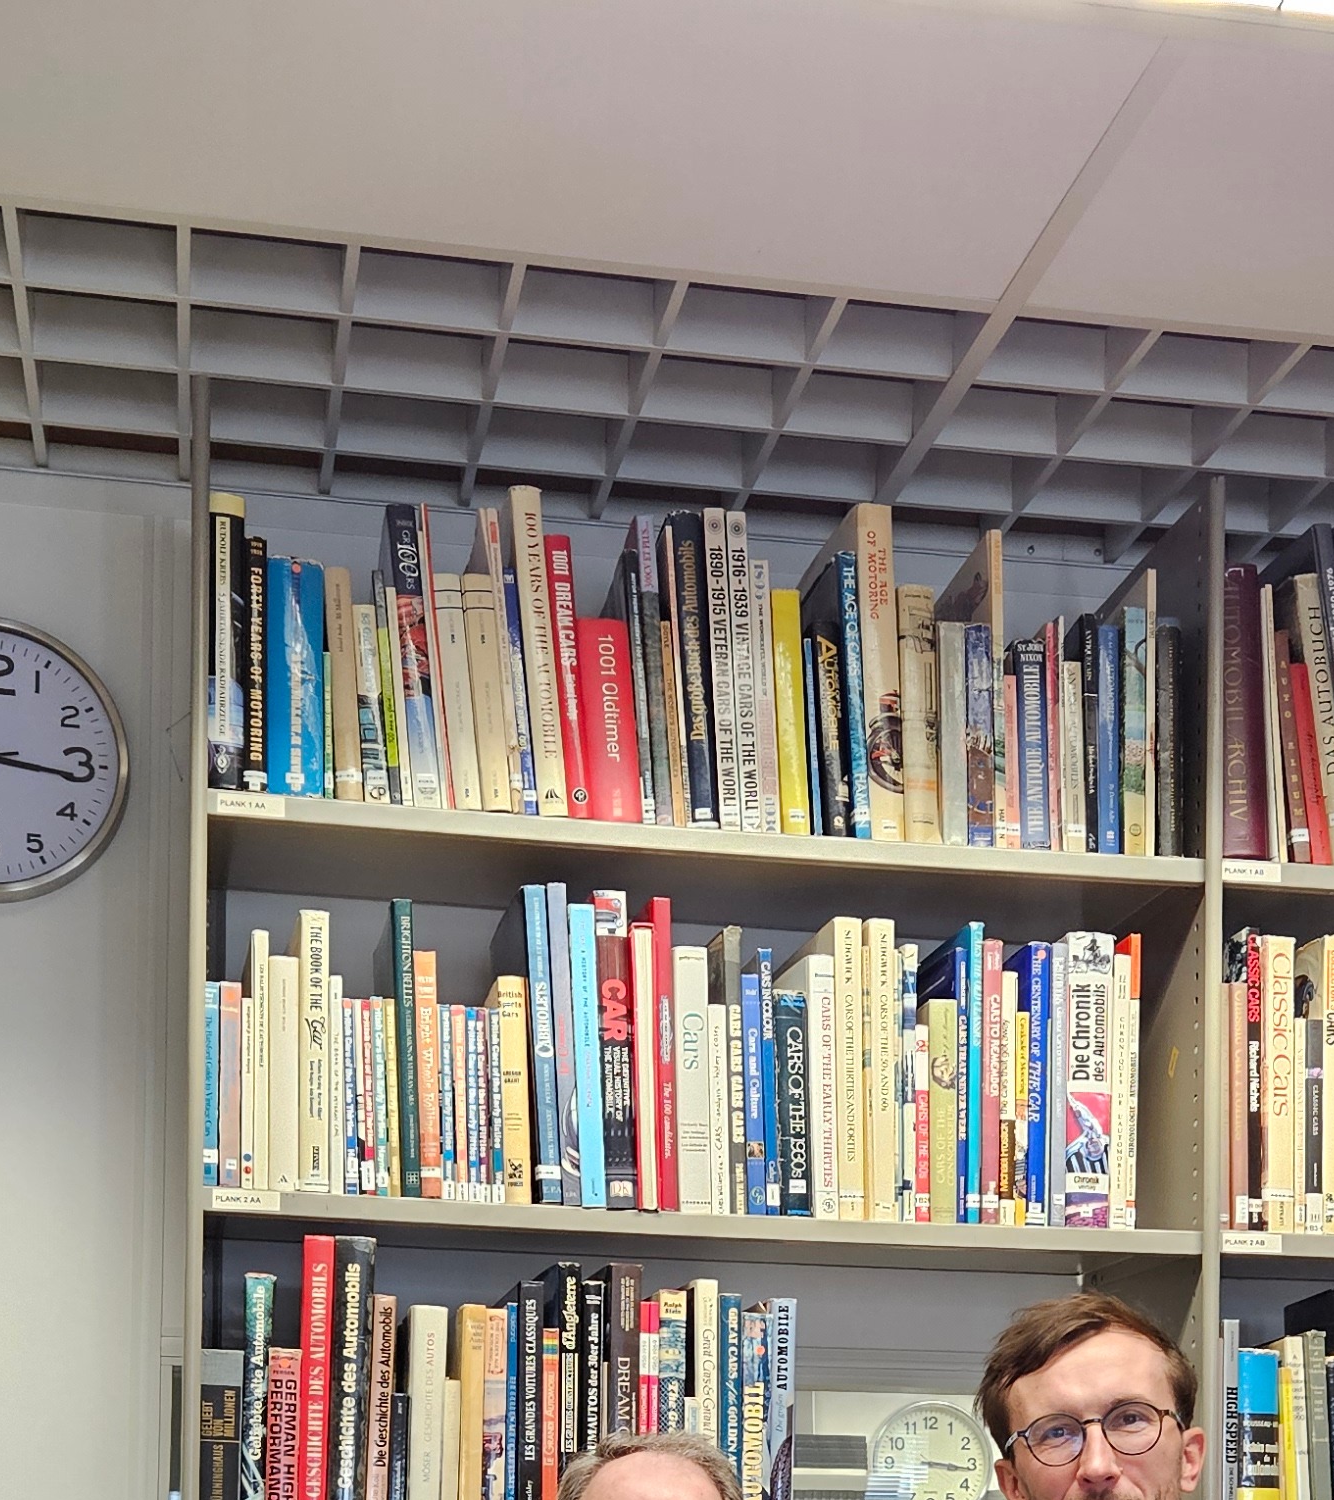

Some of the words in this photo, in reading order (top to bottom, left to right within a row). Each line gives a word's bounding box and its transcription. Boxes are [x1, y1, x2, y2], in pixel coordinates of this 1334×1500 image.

[524, 512, 537, 536] 100
[527, 539, 542, 595] YEARS
[552, 550, 568, 575] 1001
[531, 598, 544, 622] OF
[554, 582, 574, 621] DREAM
[534, 625, 547, 653] THE
[558, 623, 578, 667] CARS
[597, 634, 617, 680] 1001
[1020, 653, 1043, 663] NIXON
[1307, 605, 1334, 731] AUTOBUCH
[35, 670, 40, 694] 1
[817, 635, 840, 751] AUTOMOBILE
[60, 706, 80, 728] 2
[536, 659, 557, 759] AUTOMOBILE
[1024, 665, 1042, 739] AUTOMOBILE
[601, 683, 621, 762] Oldtimer
[63, 747, 95, 782] 3
[1026, 742, 1045, 802] ANTIQUE
[56, 802, 77, 821] 4
[220, 799, 241, 810] PLANK
[244, 801, 247, 809] 1
[251, 801, 267, 811] AA
[1027, 805, 1045, 835] THE
[26, 833, 43, 854] 5
[1224, 867, 1247, 875] PLANK
[310, 925, 323, 945] THE
[310, 946, 323, 976] BOOK
[1248, 934, 1260, 986] CLASSIC
[311, 977, 323, 992] OF
[310, 993, 323, 1012] THE
[601, 979, 628, 1042] CAR
[1248, 989, 1260, 1022] CARS
[1271, 952, 1292, 1051] Classic
[1071, 983, 1092, 1058] Chronik
[1094, 984, 1106, 1057] Automobils
[682, 1011, 705, 1071] Cars
[1073, 1061, 1092, 1081] Die
[1094, 1060, 1105, 1082] des
[1272, 1053, 1292, 1117] Cars
[1073, 1176, 1101, 1184] Chronik
[215, 1195, 241, 1203] PLANK
[1224, 1238, 1247, 1246] PLANK
[309, 1263, 329, 1362] AUTOMOBILS
[343, 1263, 361, 1358] Automobils
[562, 1276, 577, 1350] d'Angleterre
[308, 1366, 325, 1403] DES
[343, 1359, 357, 1397] des
[617, 1356, 631, 1423] DREAM
[284, 1378, 297, 1450] GERMAN
[903, 1421, 917, 1435] 11
[923, 1416, 938, 1430] 12
[947, 1422, 953, 1435] 1
[305, 1406, 322, 1498] GESCHICHTE
[337, 1401, 355, 1489] Geschichte
[889, 1437, 905, 1451] 10
[961, 1436, 970, 1450] 2
[884, 1456, 894, 1469] 9
[967, 1457, 977, 1471] 3
[960, 1478, 969, 1491] 4
